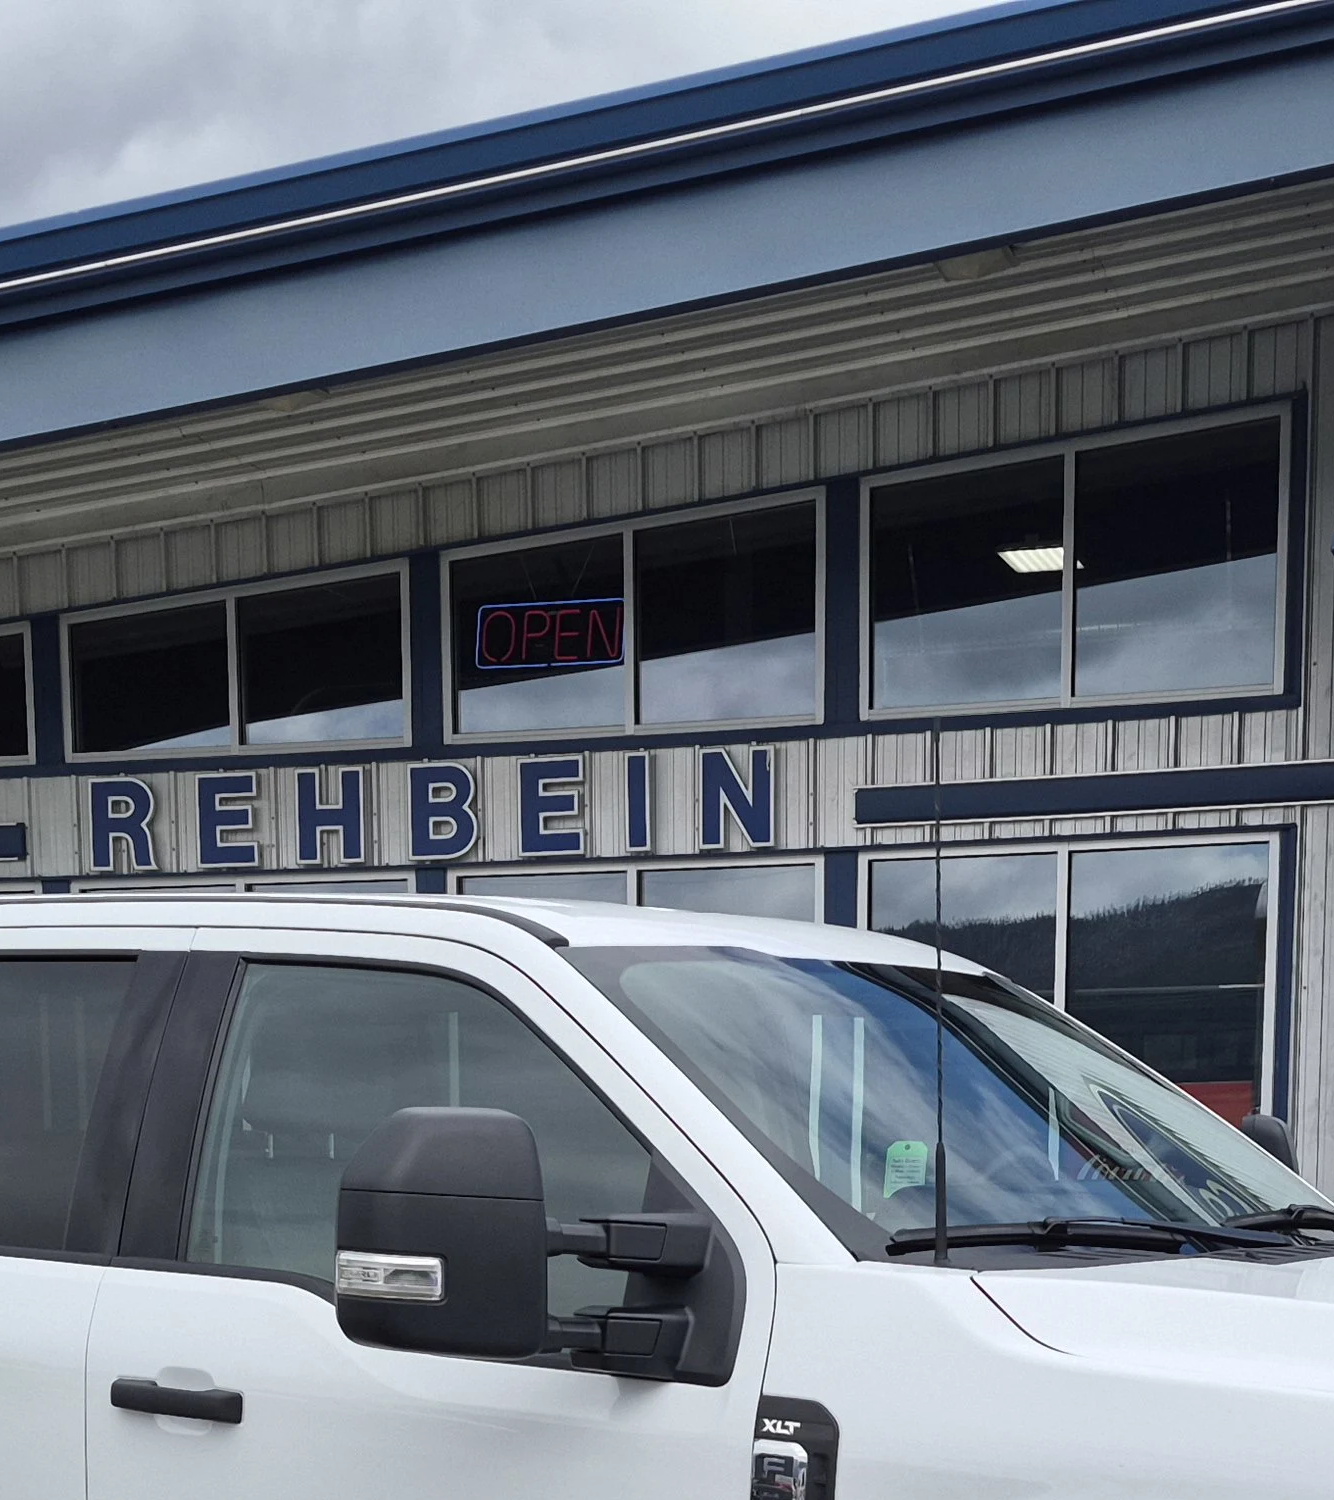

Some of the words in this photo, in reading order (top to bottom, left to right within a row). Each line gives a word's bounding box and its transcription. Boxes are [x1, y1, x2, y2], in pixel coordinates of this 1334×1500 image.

[482, 607, 623, 663] OPEN
[87, 743, 777, 873] REHBEIN
[762, 1418, 802, 1435] XLT
